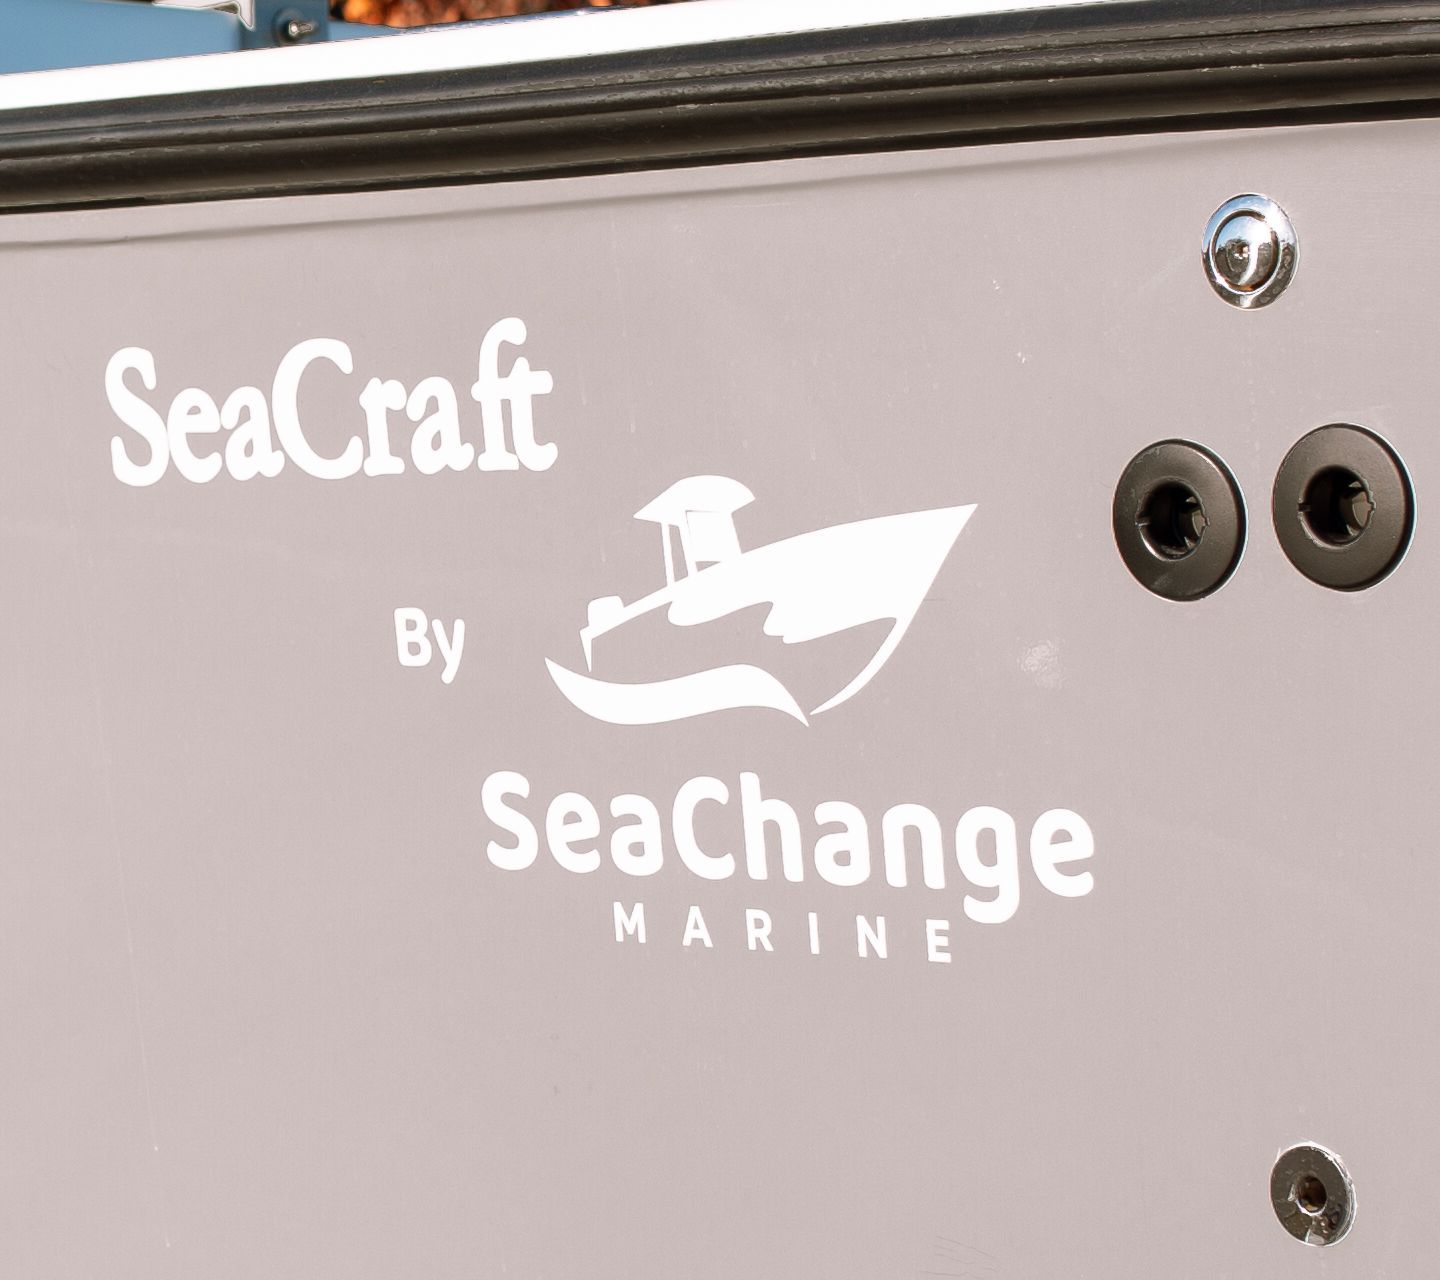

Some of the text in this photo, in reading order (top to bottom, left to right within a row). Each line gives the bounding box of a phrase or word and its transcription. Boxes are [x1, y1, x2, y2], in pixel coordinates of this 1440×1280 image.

[104, 317, 559, 487] SeaCraft
[394, 607, 466, 684] By
[481, 770, 1095, 923] SeaChange
[613, 901, 953, 963] MARINE
